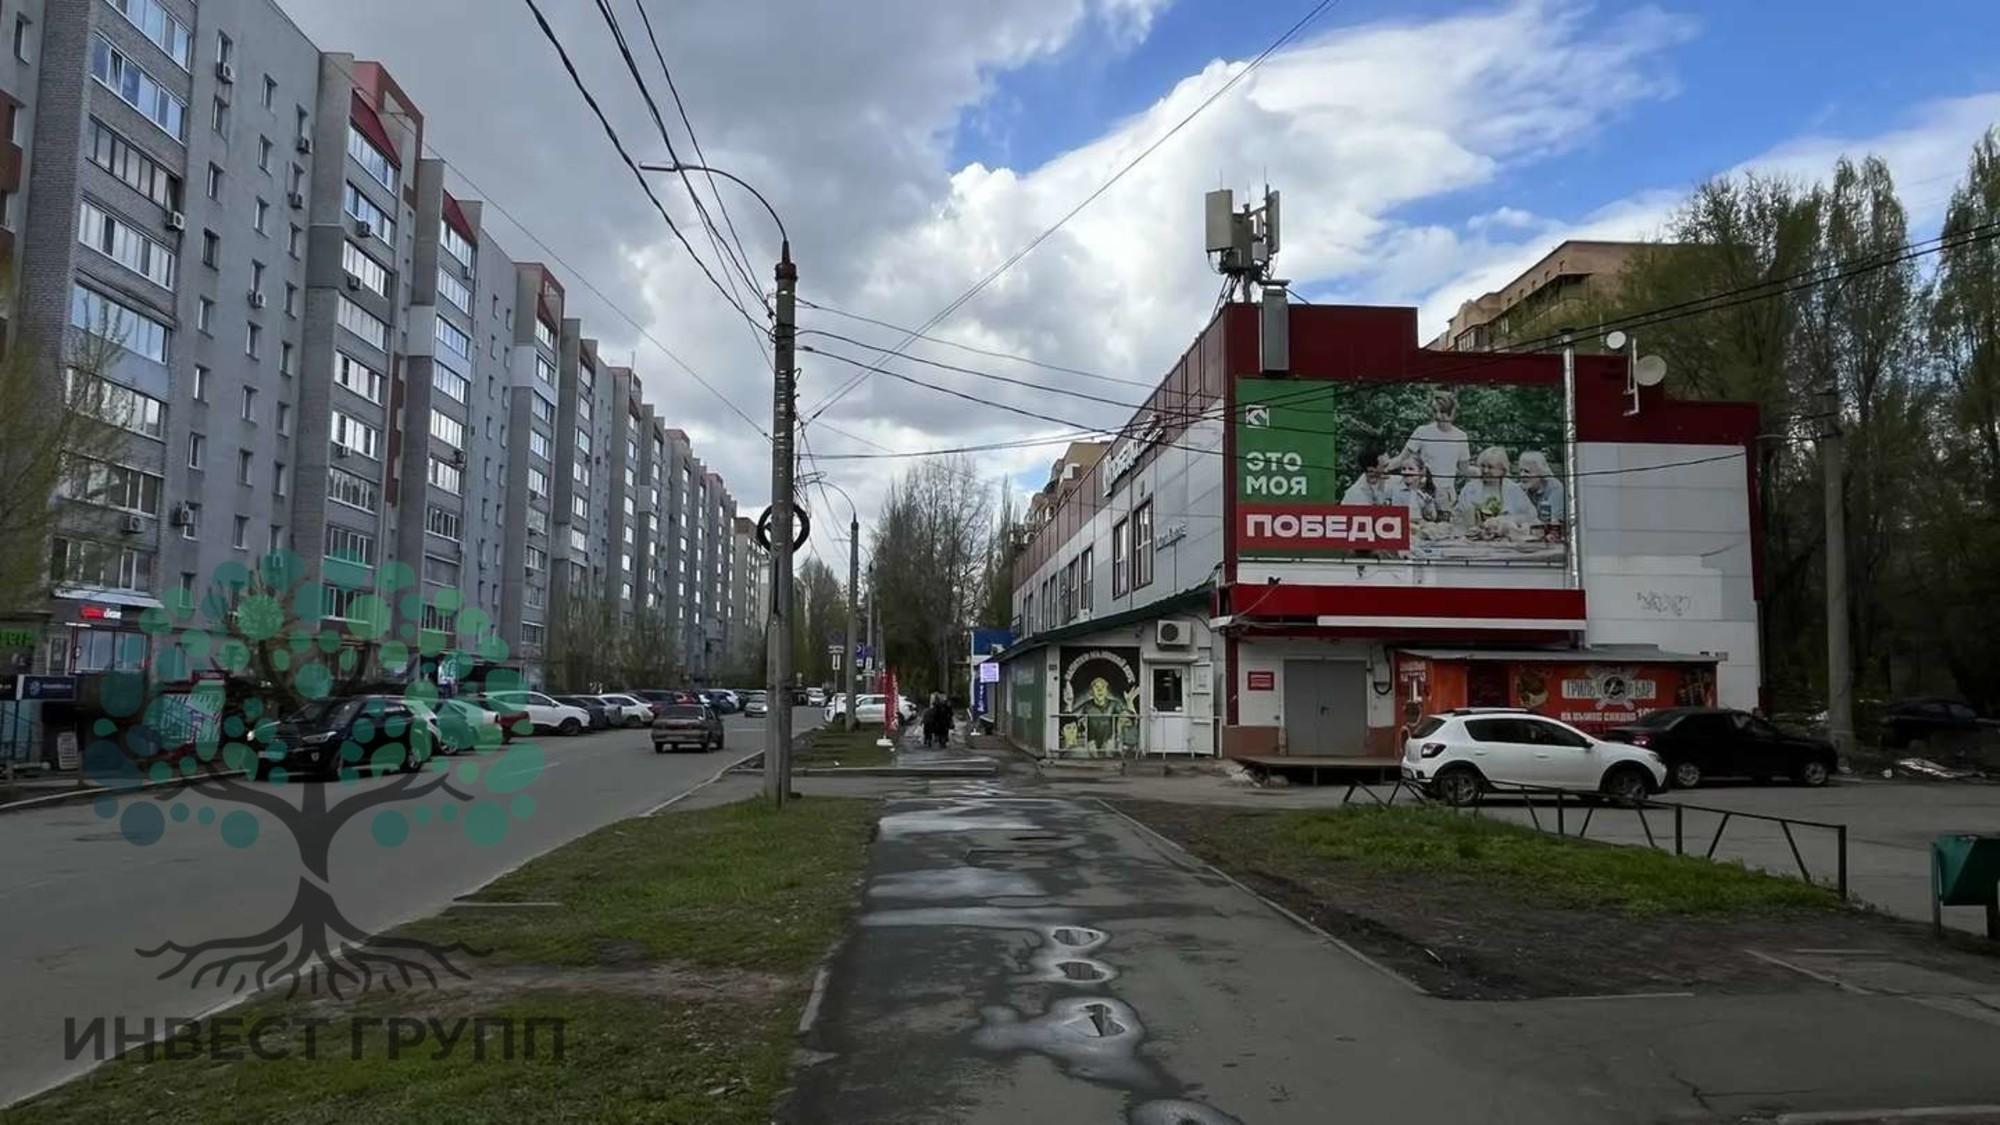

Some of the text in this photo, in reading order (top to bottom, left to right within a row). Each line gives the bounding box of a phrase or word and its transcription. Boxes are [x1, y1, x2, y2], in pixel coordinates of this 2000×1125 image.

[1246, 452, 1302, 472] ЭТО
[1246, 475, 1307, 495] МОЯ
[1246, 514, 1402, 542] ПОБЕДА
[1635, 681, 1653, 697] БАР
